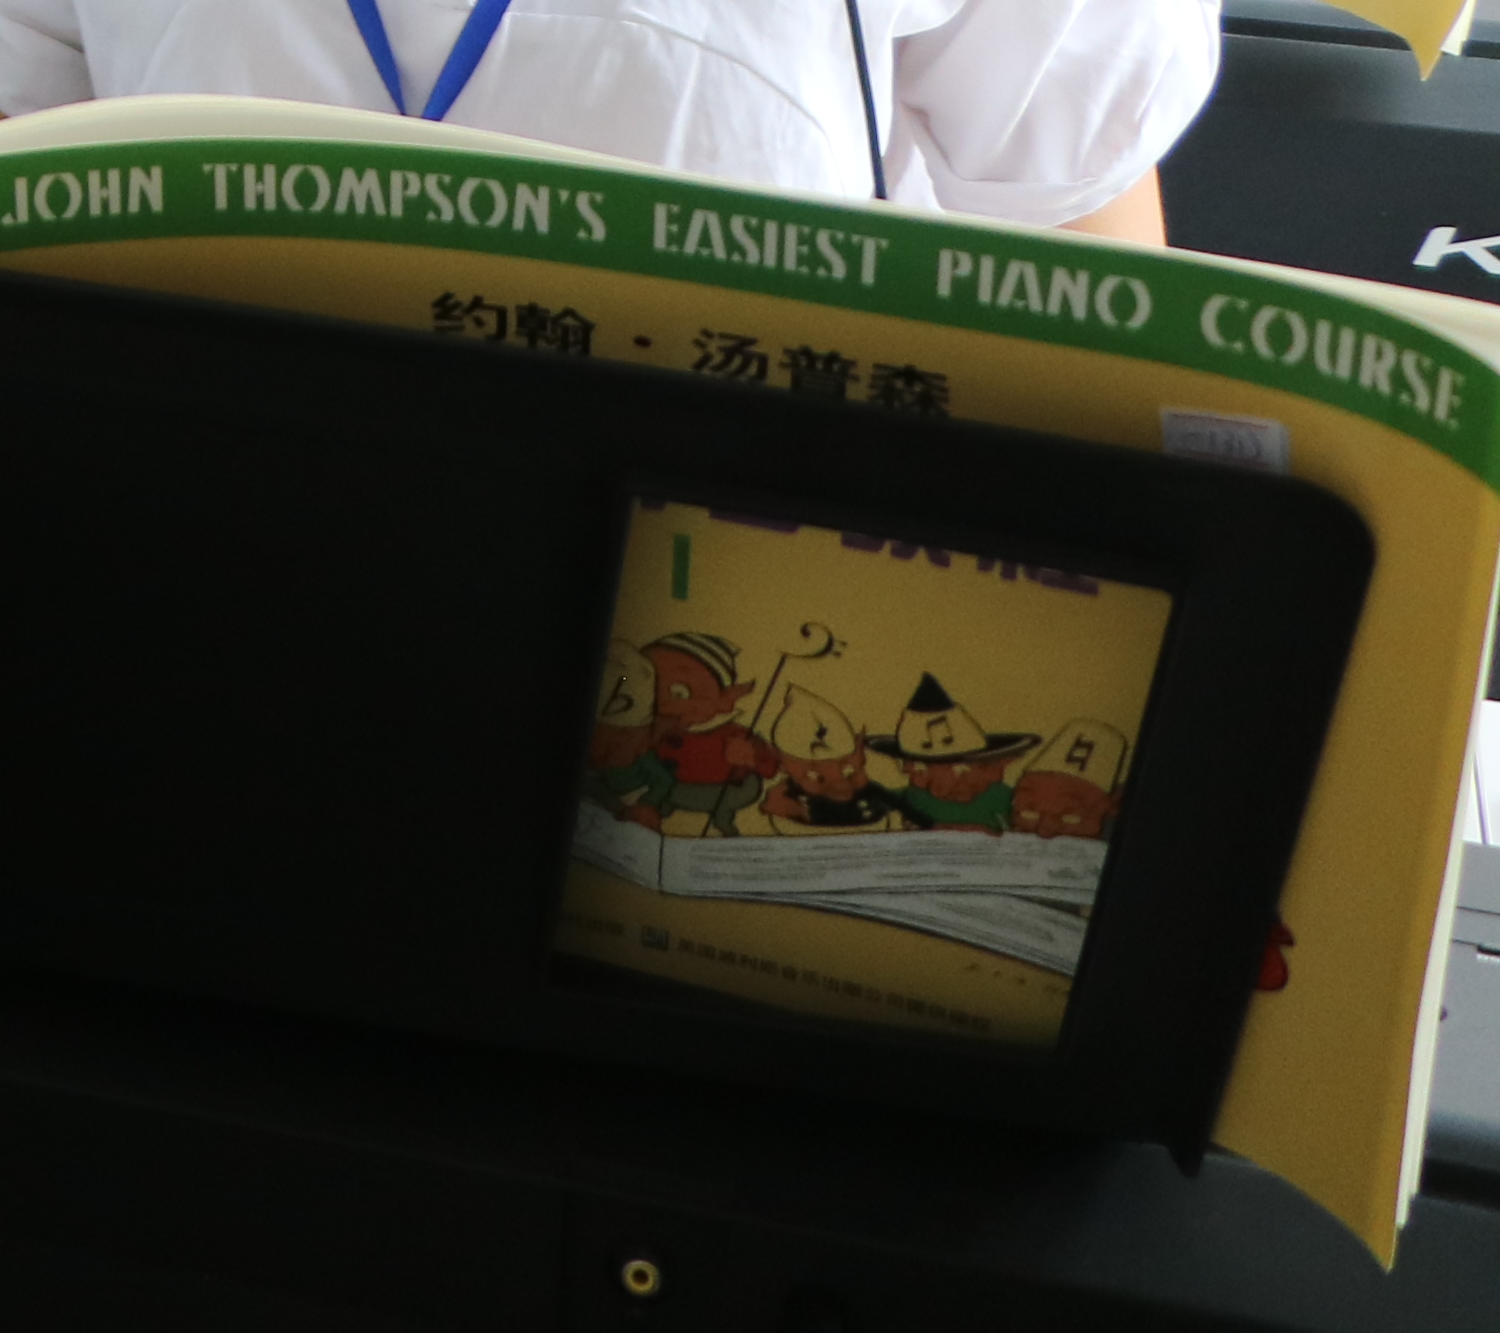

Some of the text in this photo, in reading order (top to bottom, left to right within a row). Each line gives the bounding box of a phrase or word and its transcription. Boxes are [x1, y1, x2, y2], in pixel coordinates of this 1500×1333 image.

[0, 162, 1465, 432] JOHN THOMPSON'S EASIEST PIANO COURSE
